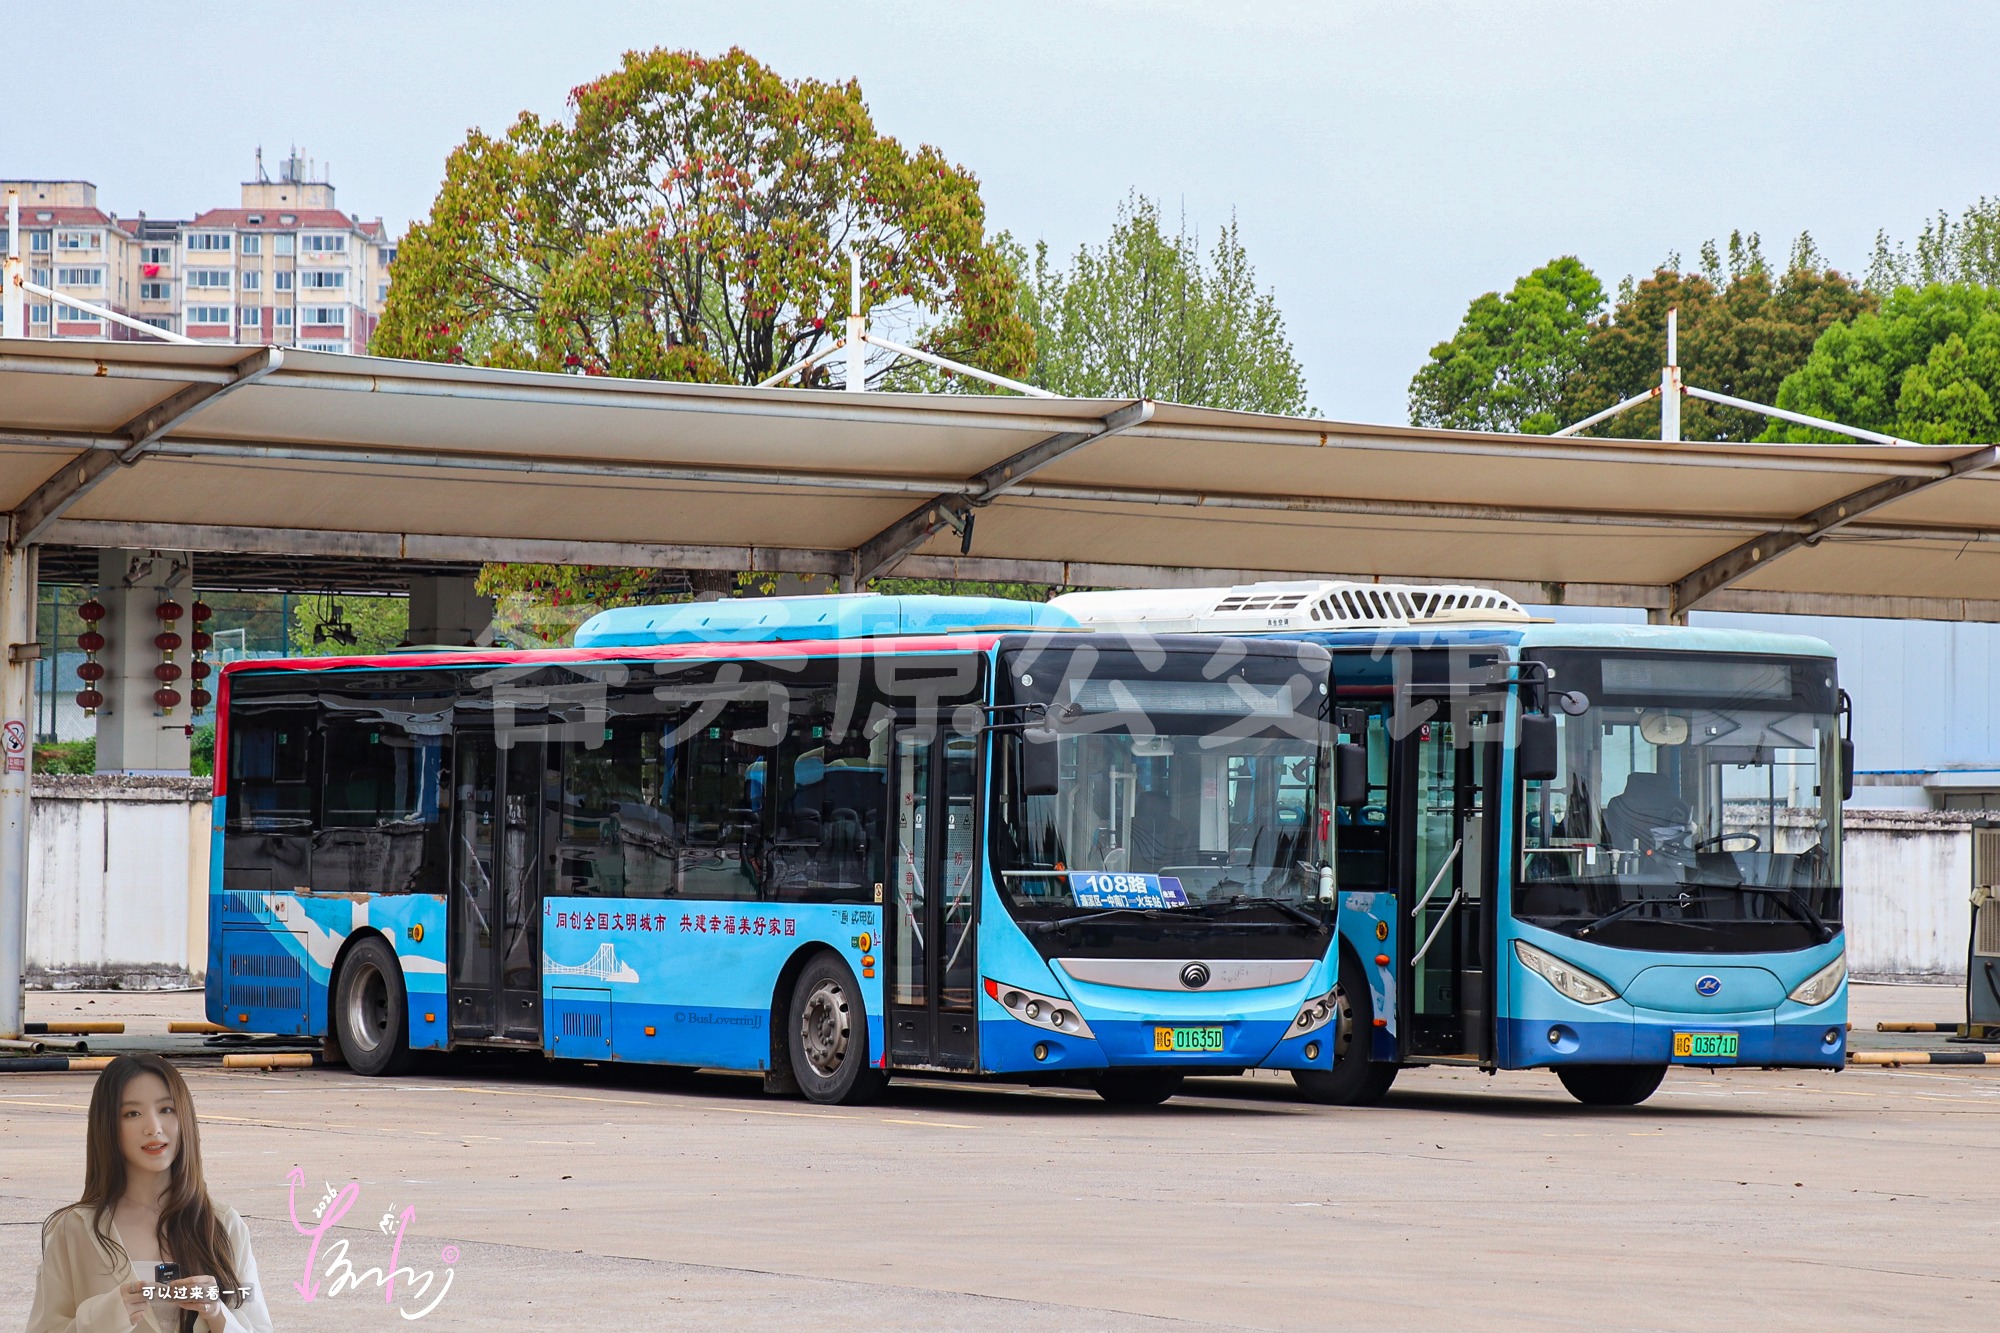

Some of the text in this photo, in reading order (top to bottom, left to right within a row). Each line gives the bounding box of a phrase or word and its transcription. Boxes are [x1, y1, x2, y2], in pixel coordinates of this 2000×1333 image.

[1086, 875, 1148, 894] 108路
[555, 911, 797, 937] 同创全国文明城市 共建幸福美好家园
